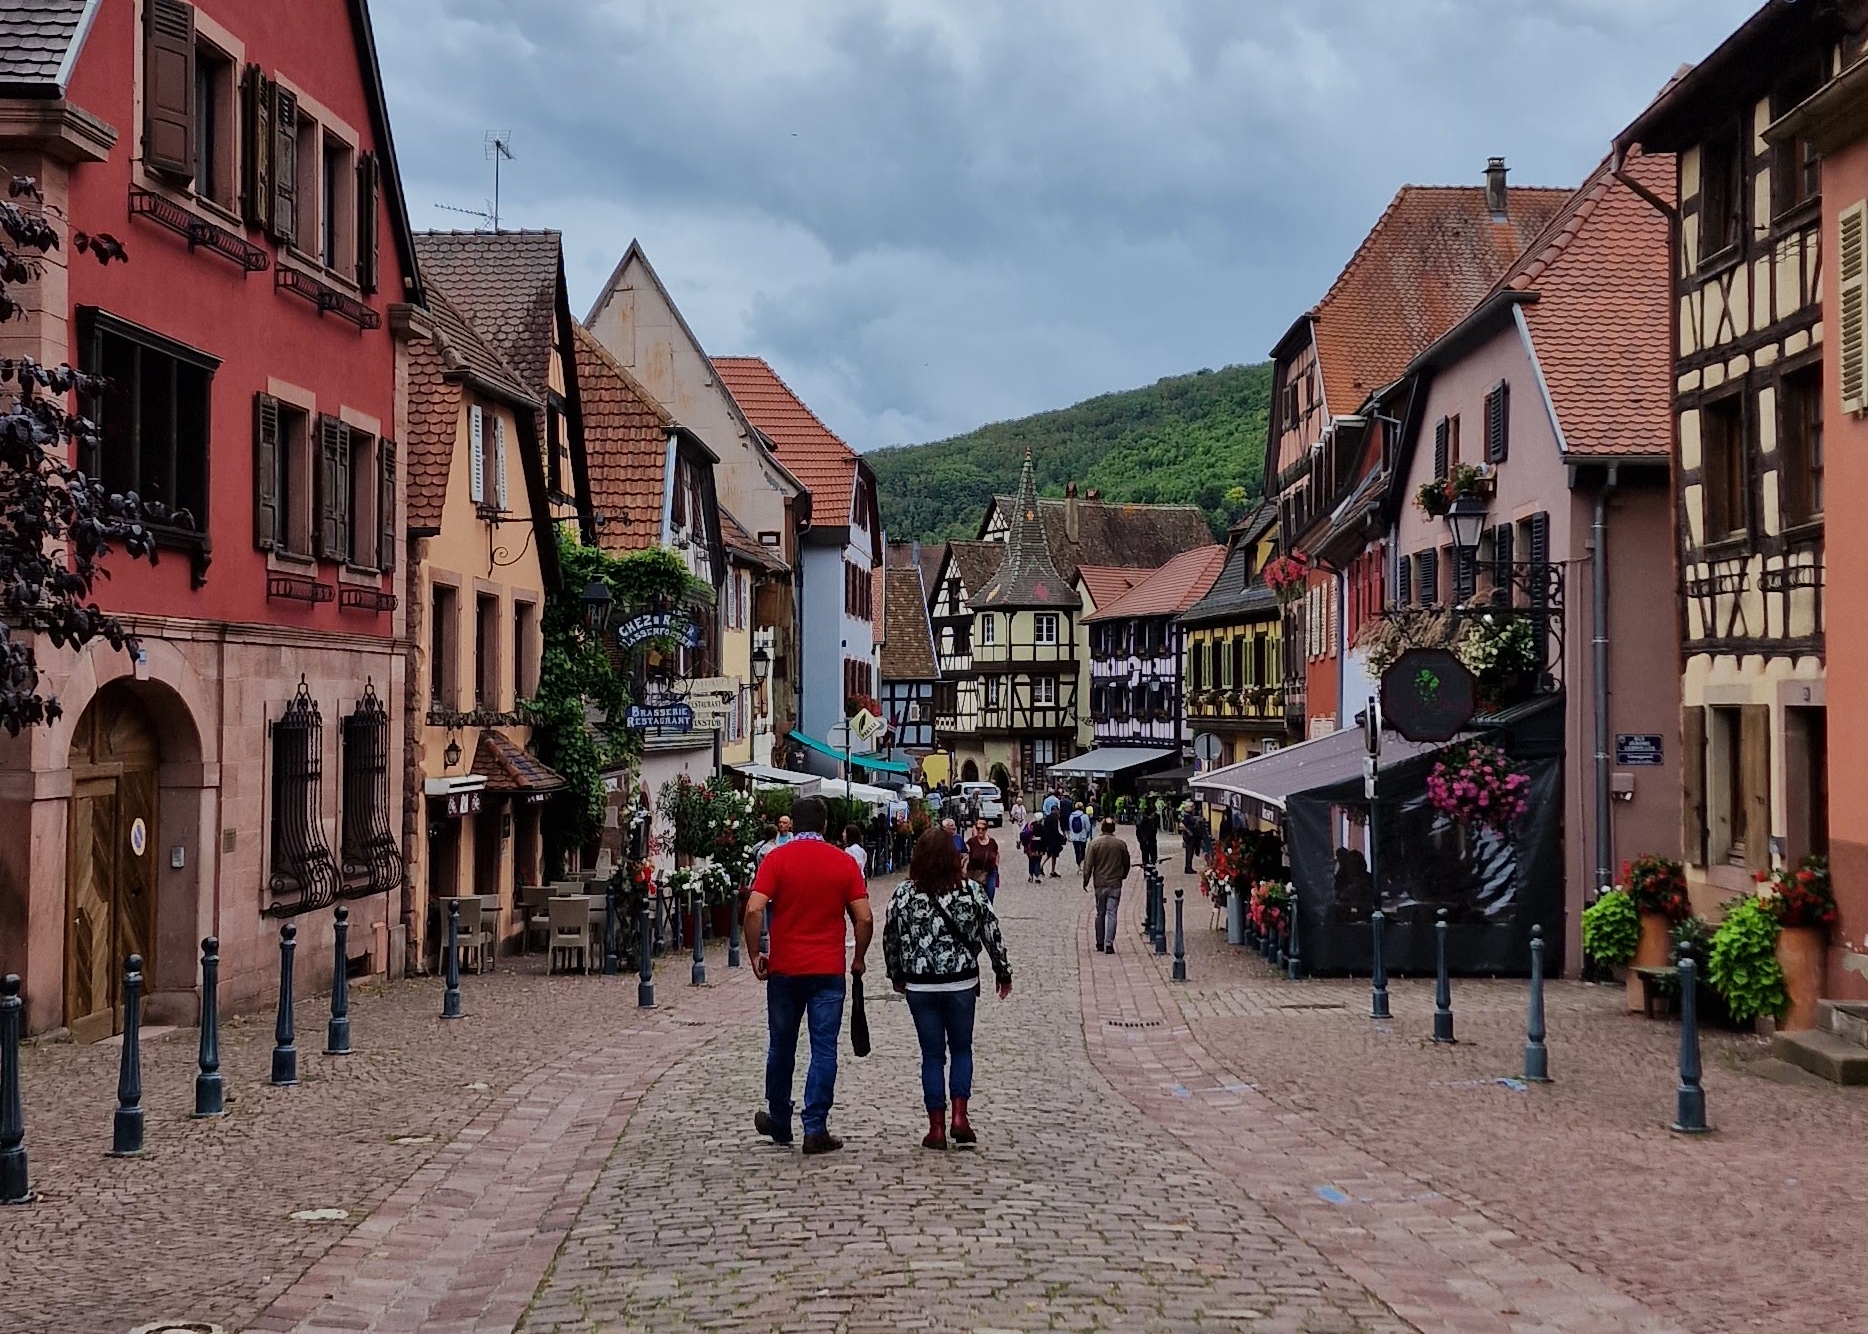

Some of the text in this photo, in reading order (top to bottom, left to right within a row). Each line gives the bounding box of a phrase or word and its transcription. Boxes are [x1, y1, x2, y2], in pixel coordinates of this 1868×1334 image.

[618, 614, 653, 637] CHEZ
[631, 705, 688, 717] BRASSERIE
[626, 716, 690, 728] RESTAURANT
